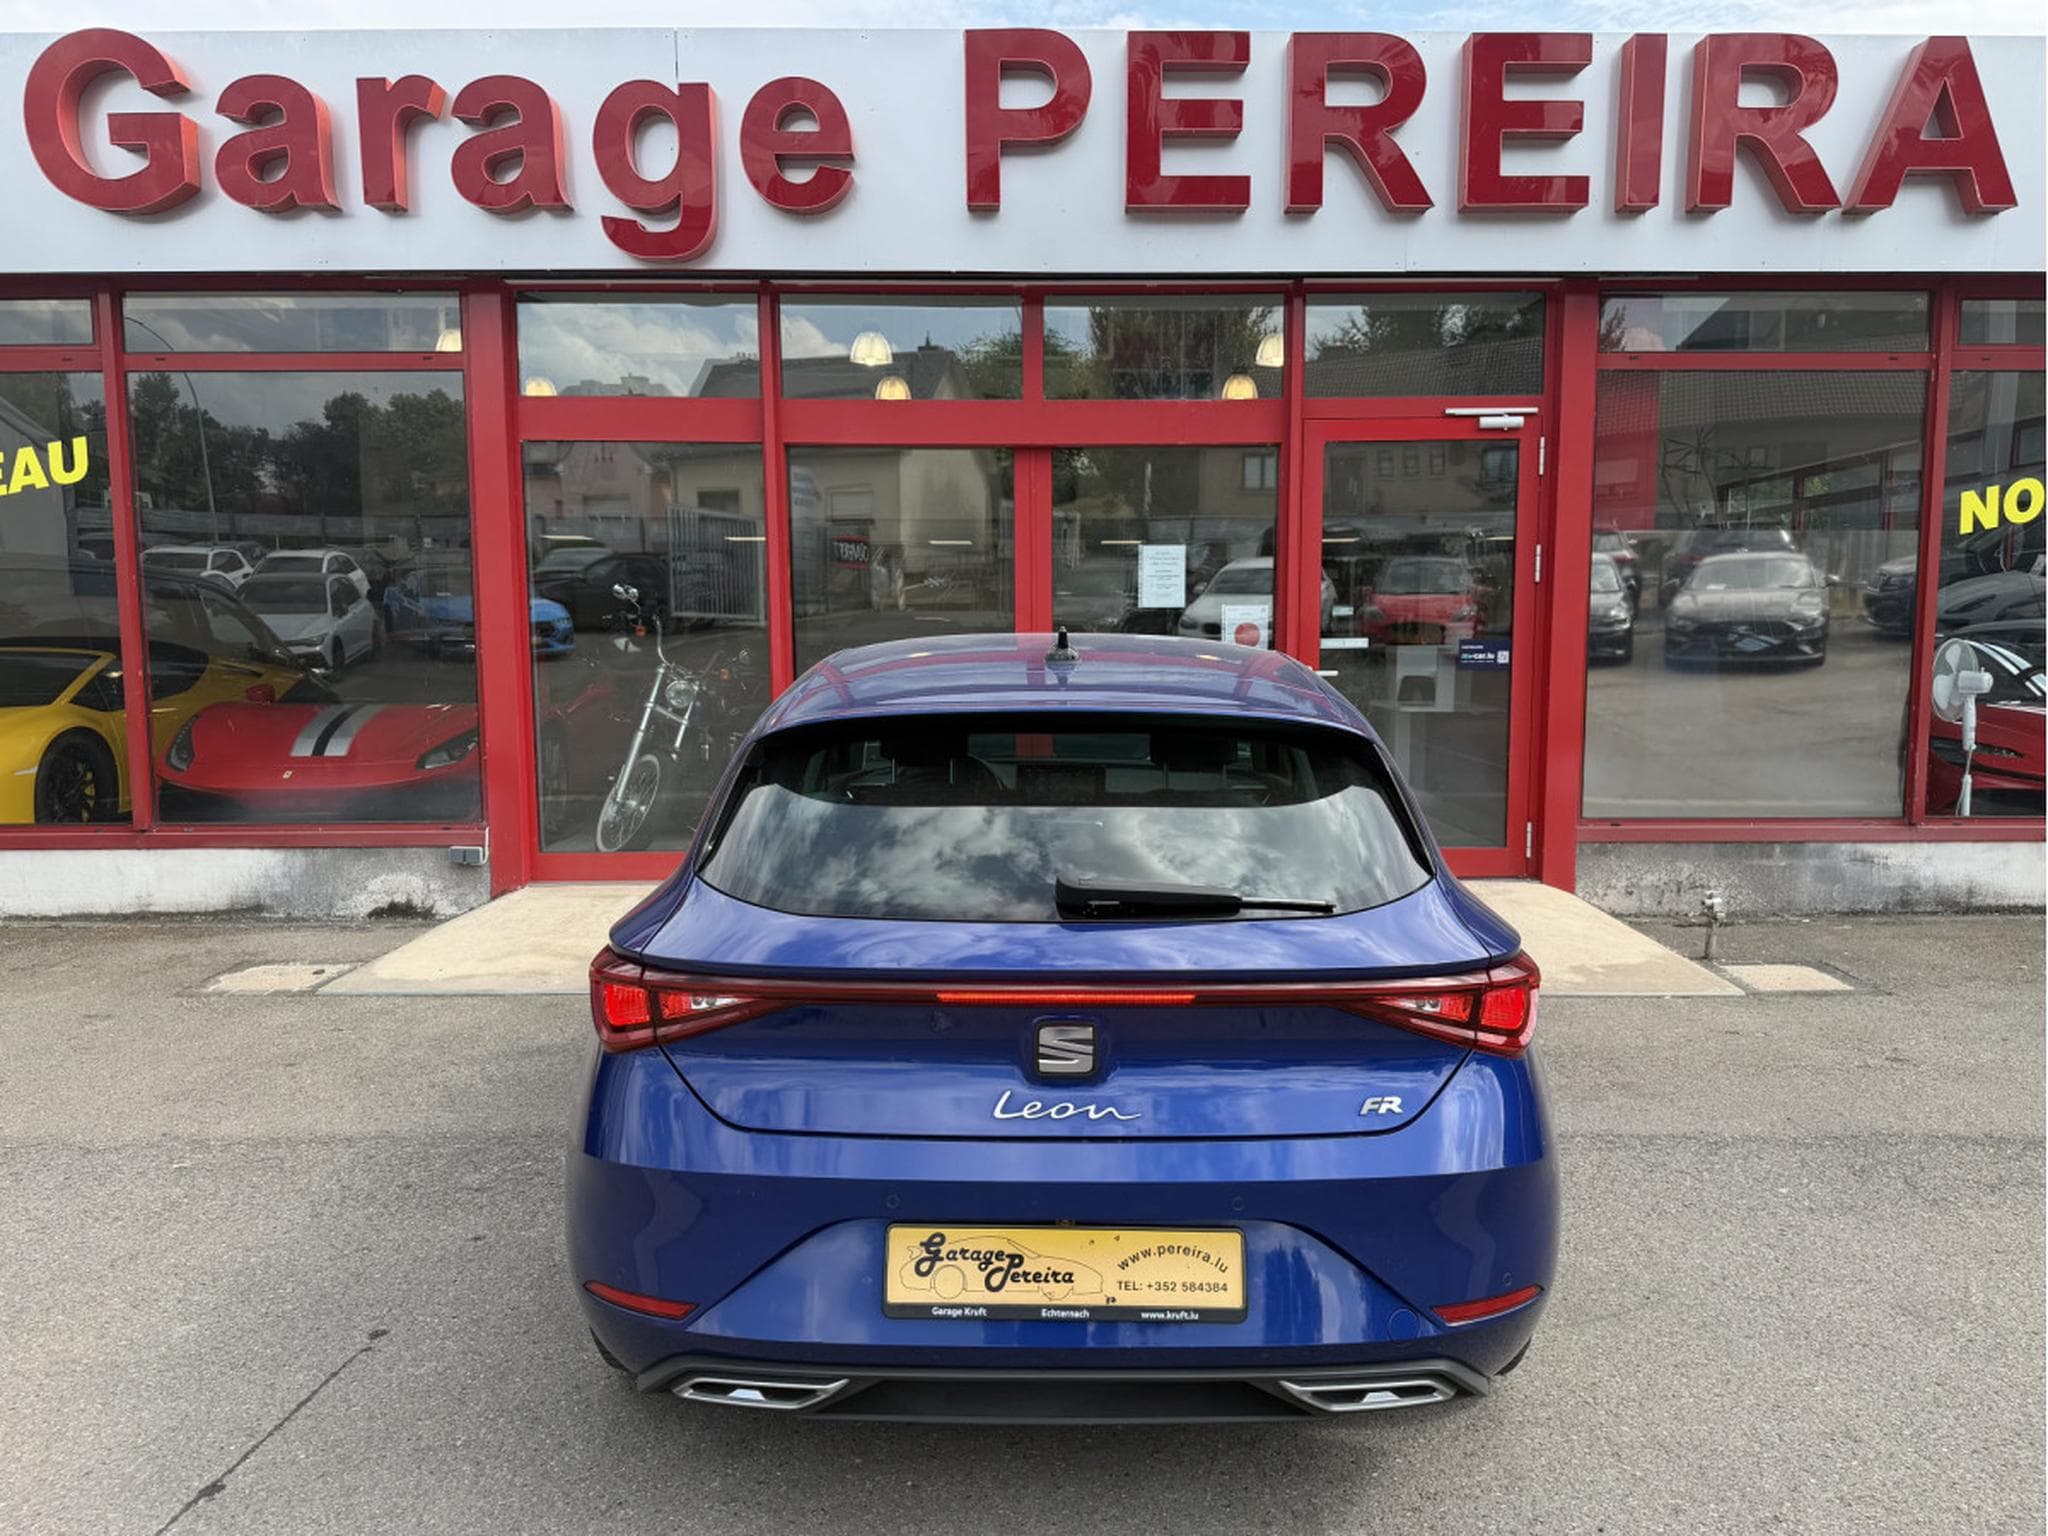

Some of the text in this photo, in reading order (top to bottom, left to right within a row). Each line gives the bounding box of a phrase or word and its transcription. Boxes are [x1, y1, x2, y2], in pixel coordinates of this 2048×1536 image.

[24, 27, 2018, 262] Garage PEREIRA
[1960, 477, 2046, 535] NO
[993, 1090, 1142, 1120] Leon
[1359, 1096, 1404, 1116] FR
[914, 1231, 1075, 1293] Garage Pereira
[1117, 1244, 1229, 1274] www.pereira.lu
[1117, 1281, 1229, 1293] TEL: +352 584384
[931, 1306, 988, 1318] Garage Kruft
[1140, 1310, 1200, 1321] www.kruft.lu
